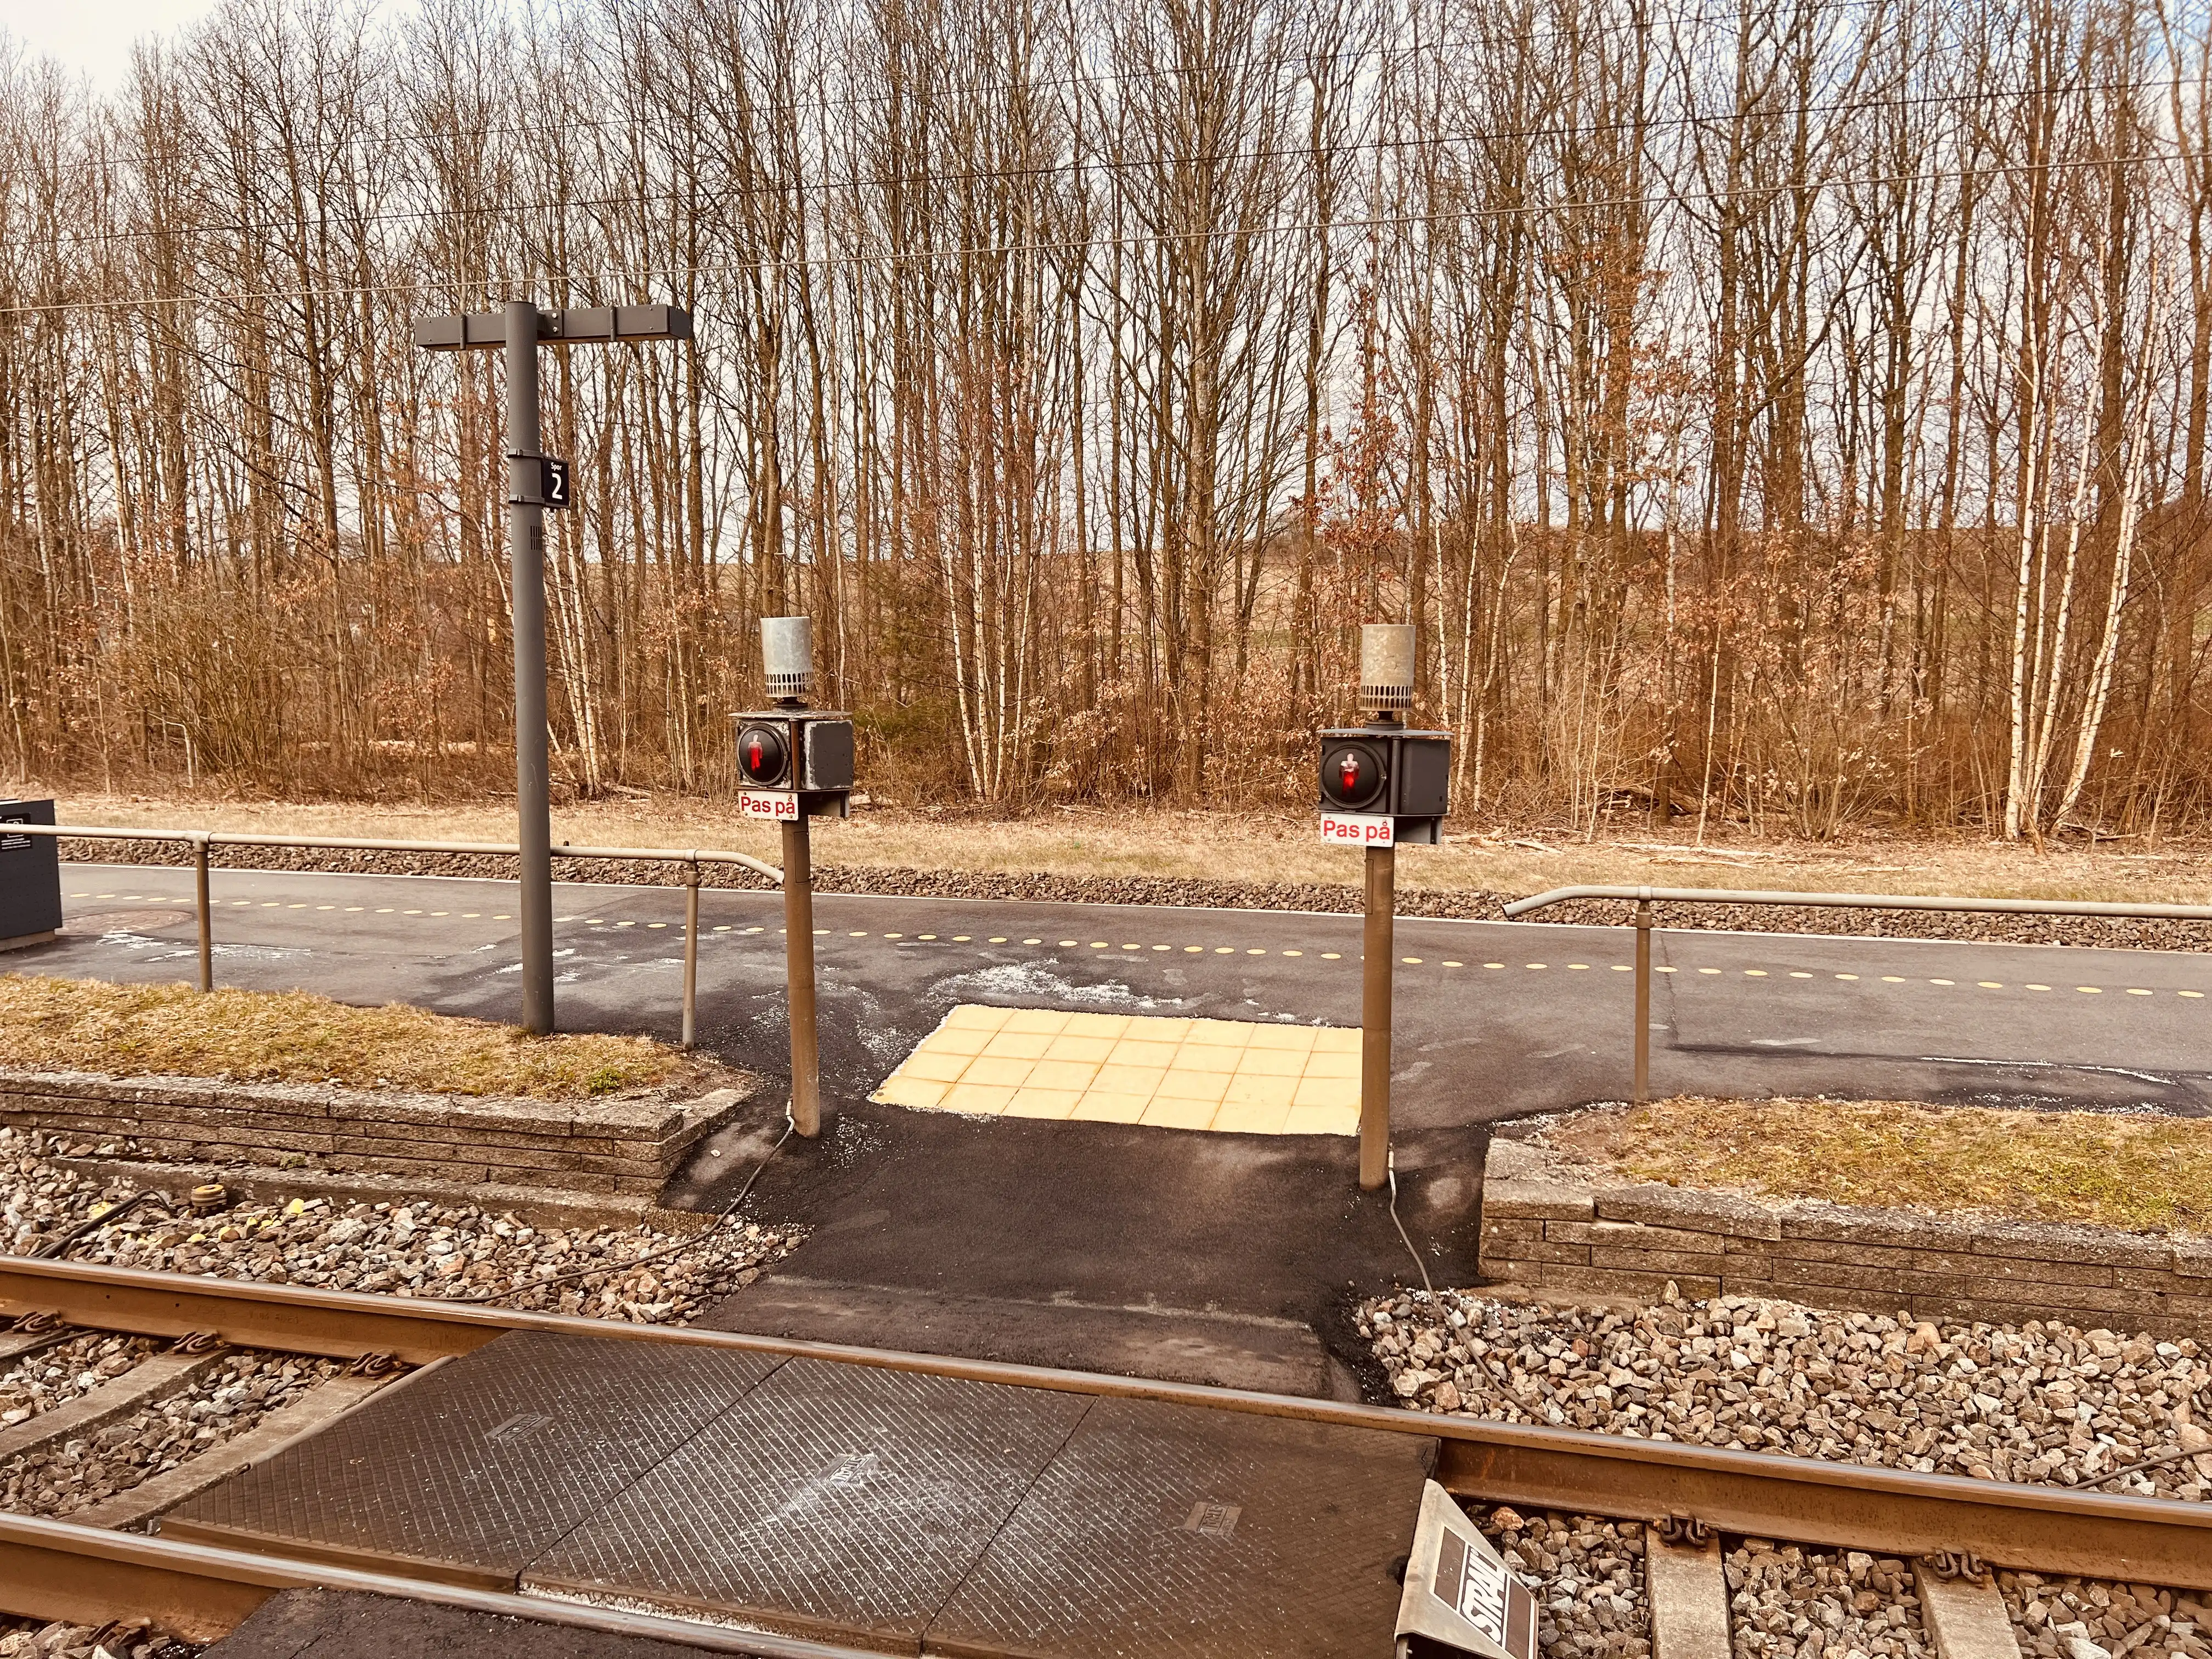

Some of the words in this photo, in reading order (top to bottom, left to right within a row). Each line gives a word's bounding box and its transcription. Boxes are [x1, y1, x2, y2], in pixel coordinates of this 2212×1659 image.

[551, 462, 562, 471] Spor
[552, 473, 562, 500] 2
[741, 796, 771, 812] Pas
[775, 795, 795, 817] på
[1323, 820, 1359, 838] Pas
[1365, 821, 1390, 842] på
